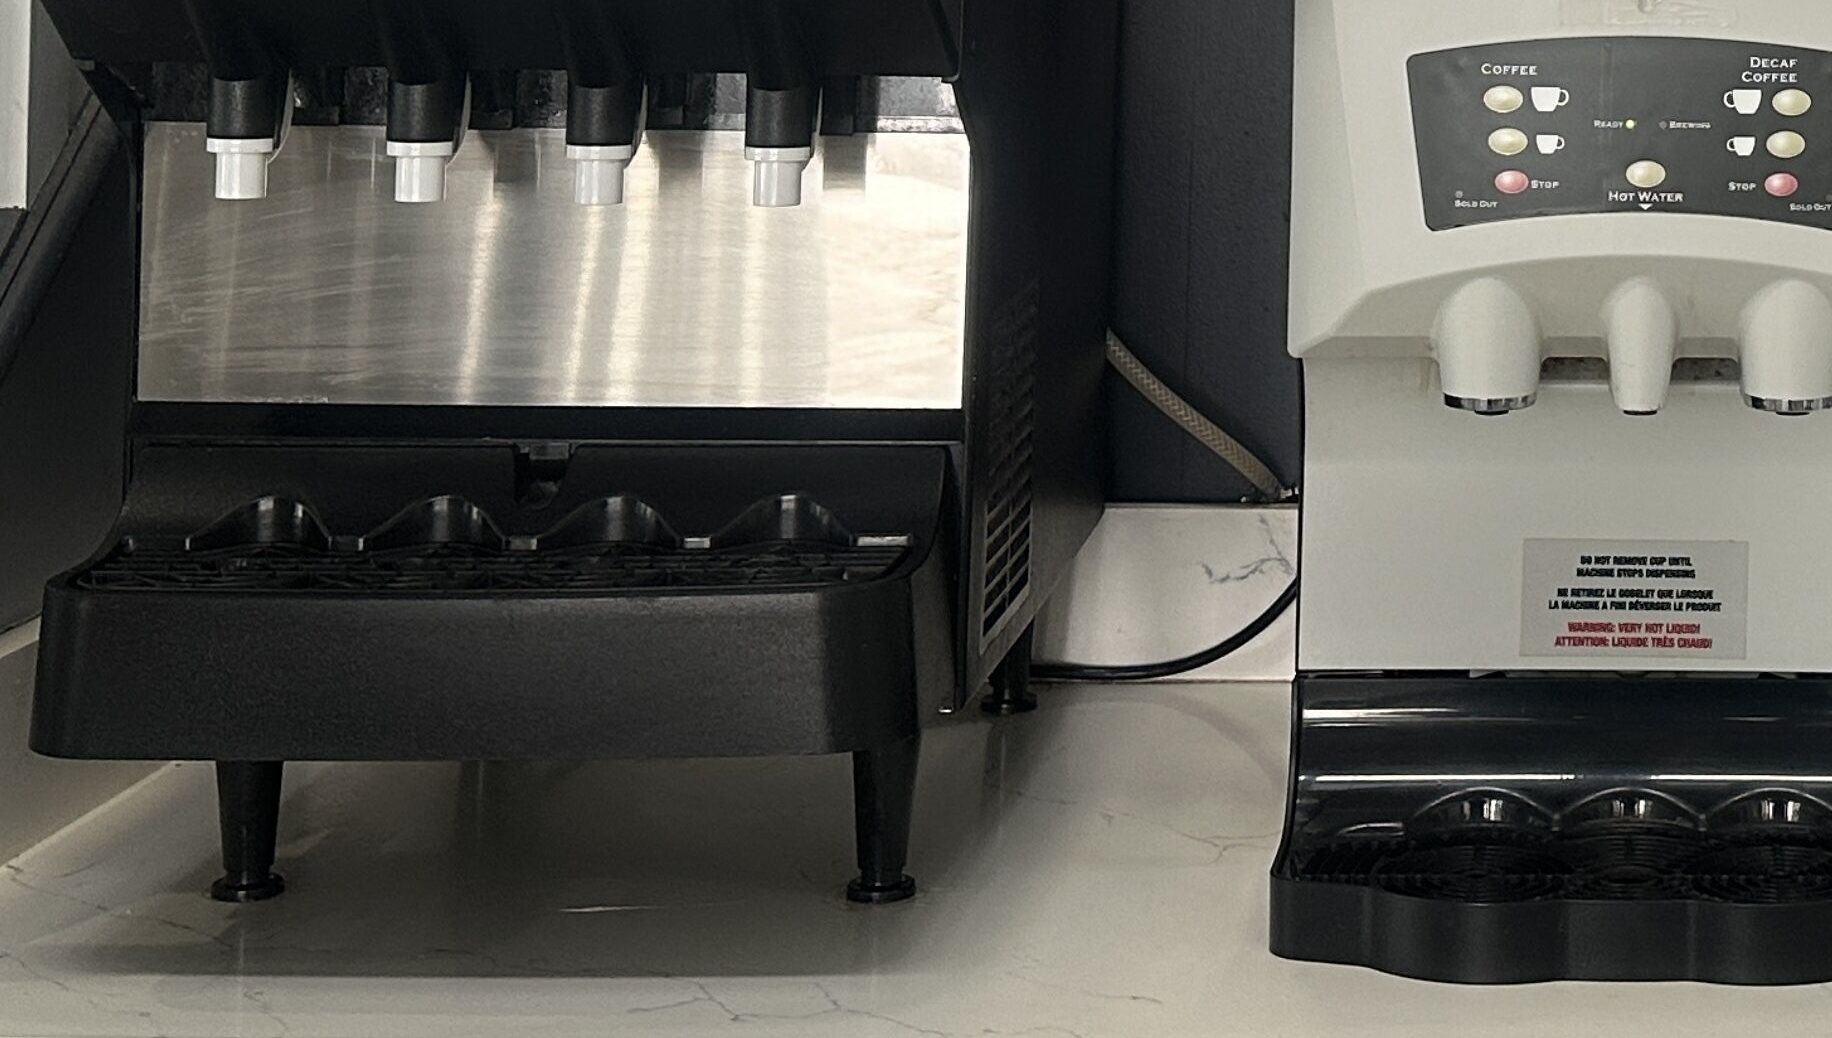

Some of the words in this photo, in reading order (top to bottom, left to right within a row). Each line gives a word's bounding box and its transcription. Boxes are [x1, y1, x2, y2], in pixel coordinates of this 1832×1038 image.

[1750, 56, 1798, 68] DECAF
[1480, 63, 1538, 75] COFFEE
[1741, 71, 1798, 83] COFFEE
[1530, 179, 1560, 189] STOP
[1728, 181, 1757, 191] STOP
[1608, 191, 1635, 202] HOT
[1637, 191, 1684, 202] WATER
[1594, 556, 1611, 565] NOT
[1649, 556, 1667, 566] CUP
[1617, 568, 1644, 578] STOPS
[1606, 589, 1617, 598] LE
[1548, 600, 1560, 610] LA
[1673, 601, 1683, 611] LE
[1618, 622, 1643, 633] VERY
